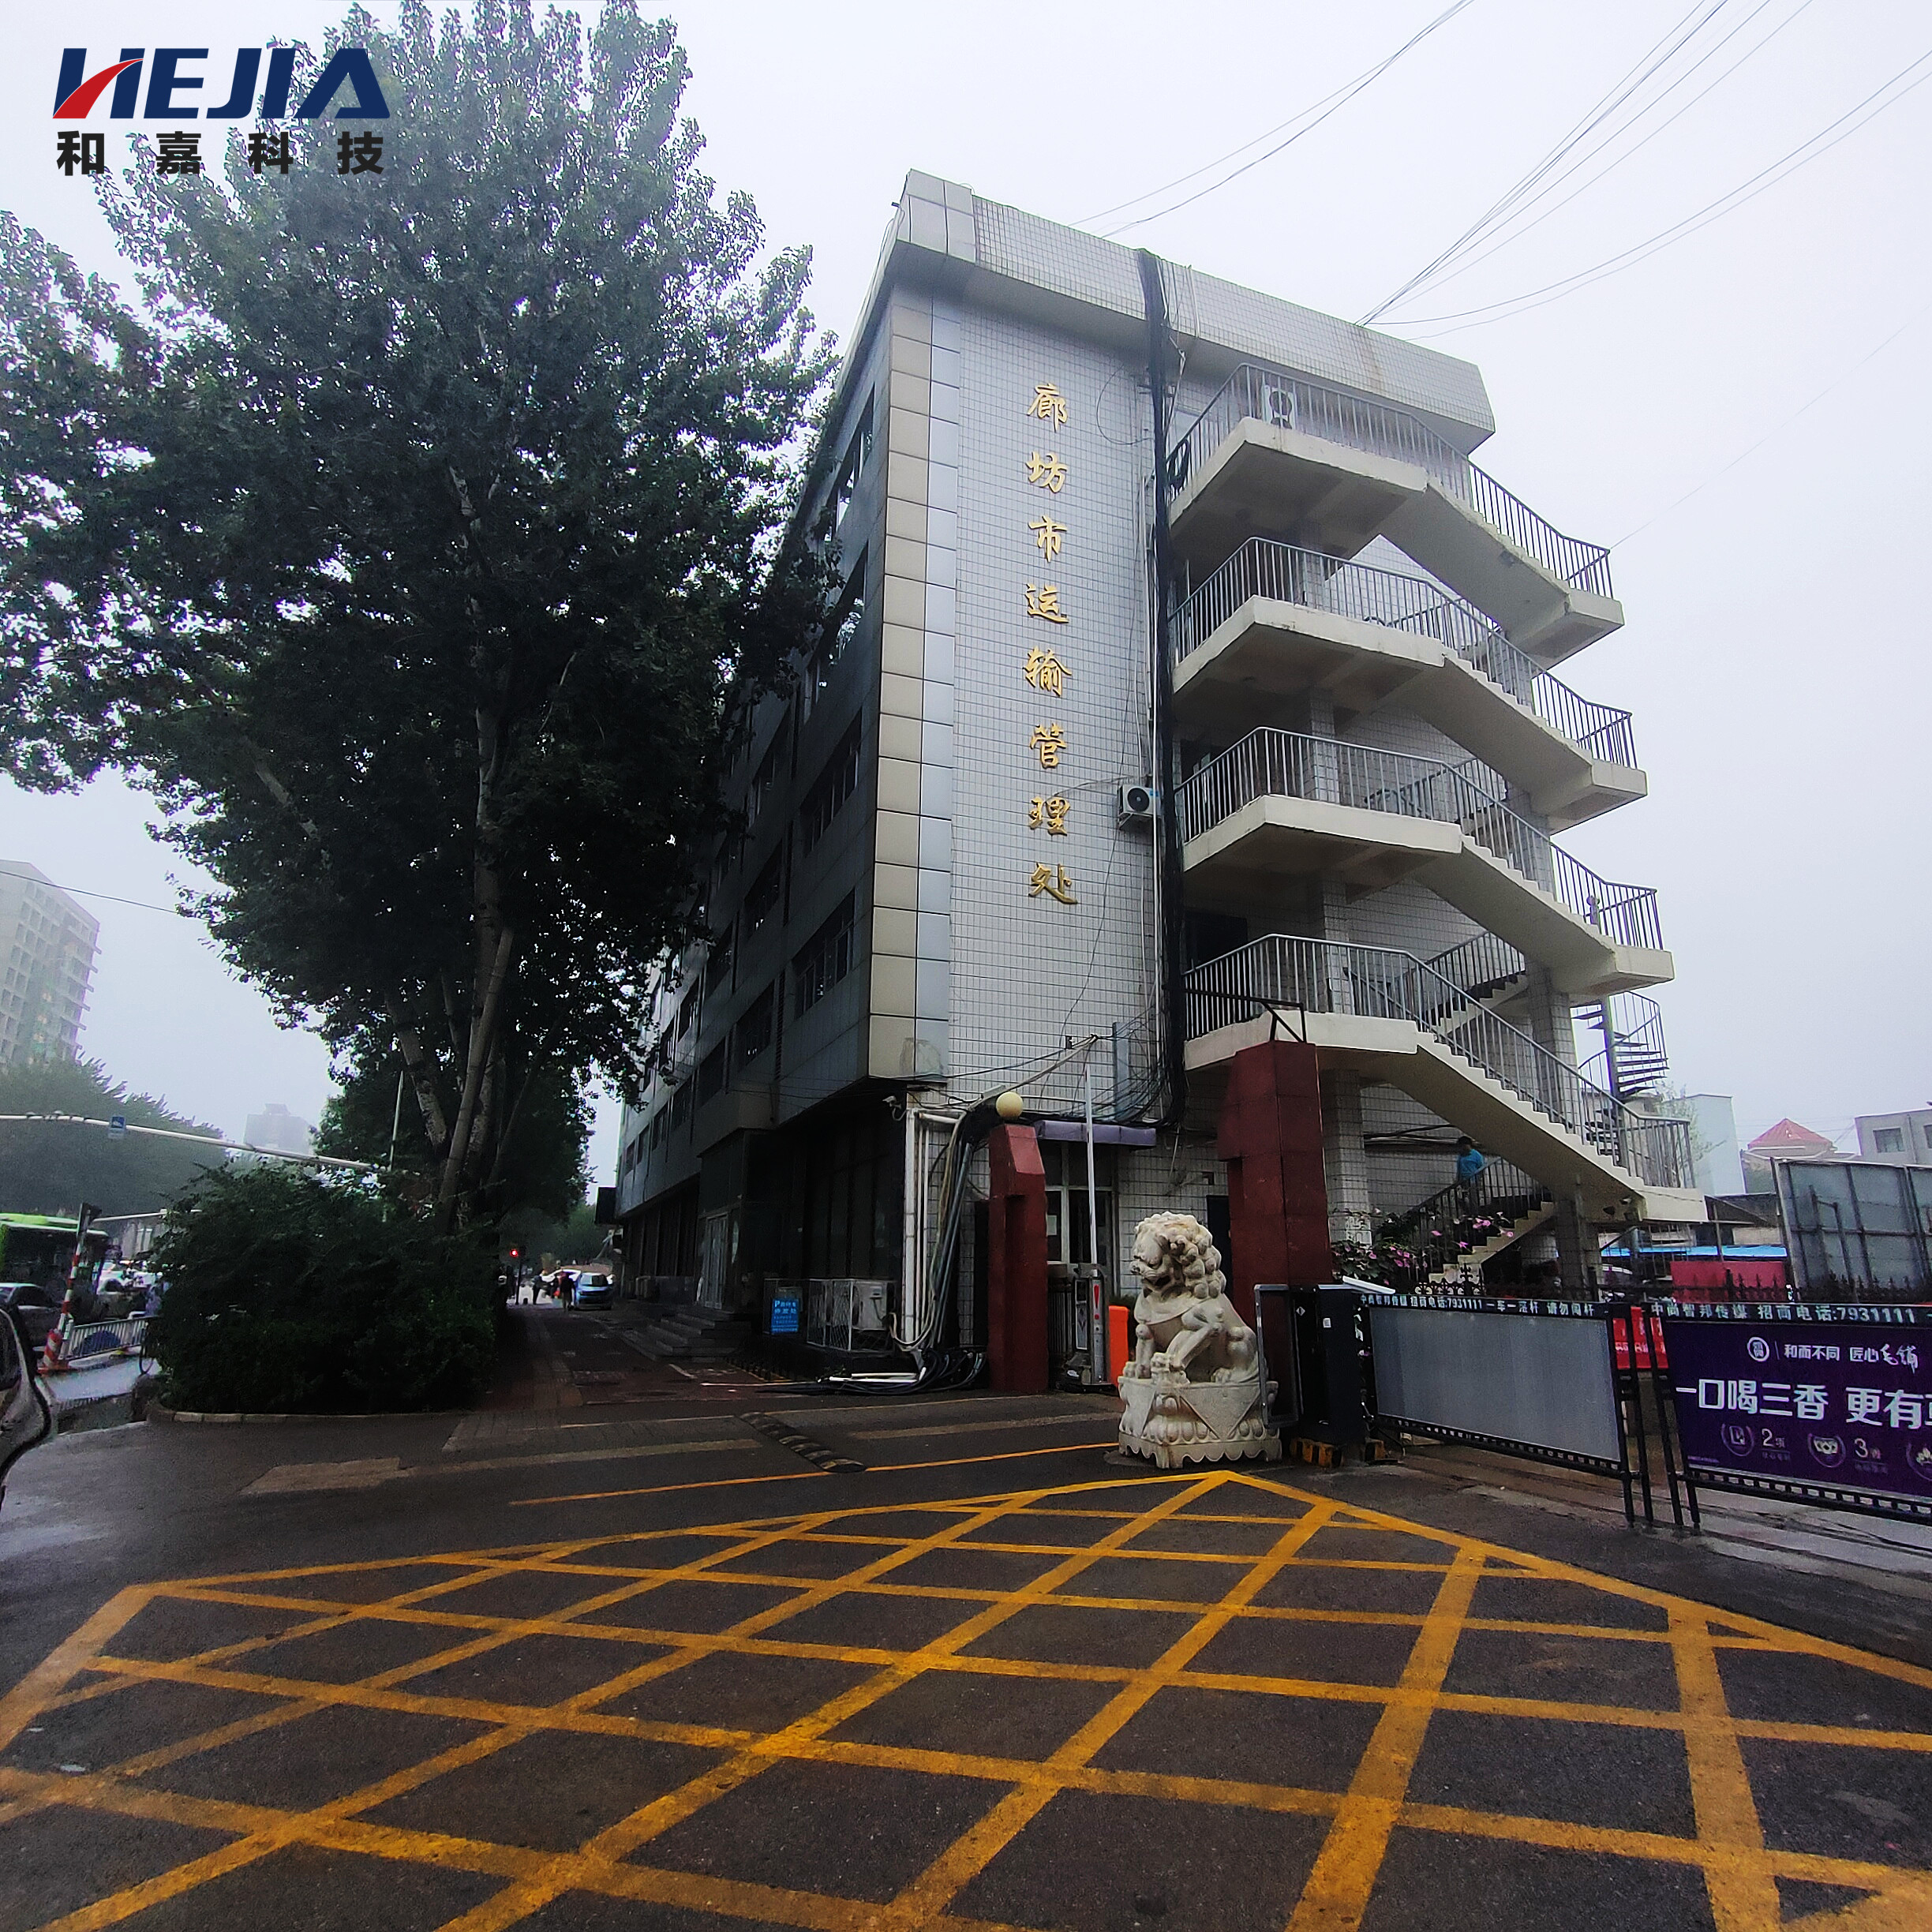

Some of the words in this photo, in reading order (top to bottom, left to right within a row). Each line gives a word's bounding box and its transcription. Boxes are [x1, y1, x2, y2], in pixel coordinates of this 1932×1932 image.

[1025, 383, 1078, 904] 廊坊市运输管理处
[1758, 1305, 1915, 1324] 招商电话:7931111
[1784, 1344, 1840, 1361] 和而不同
[1676, 1379, 1829, 1421] 一口喝三香
